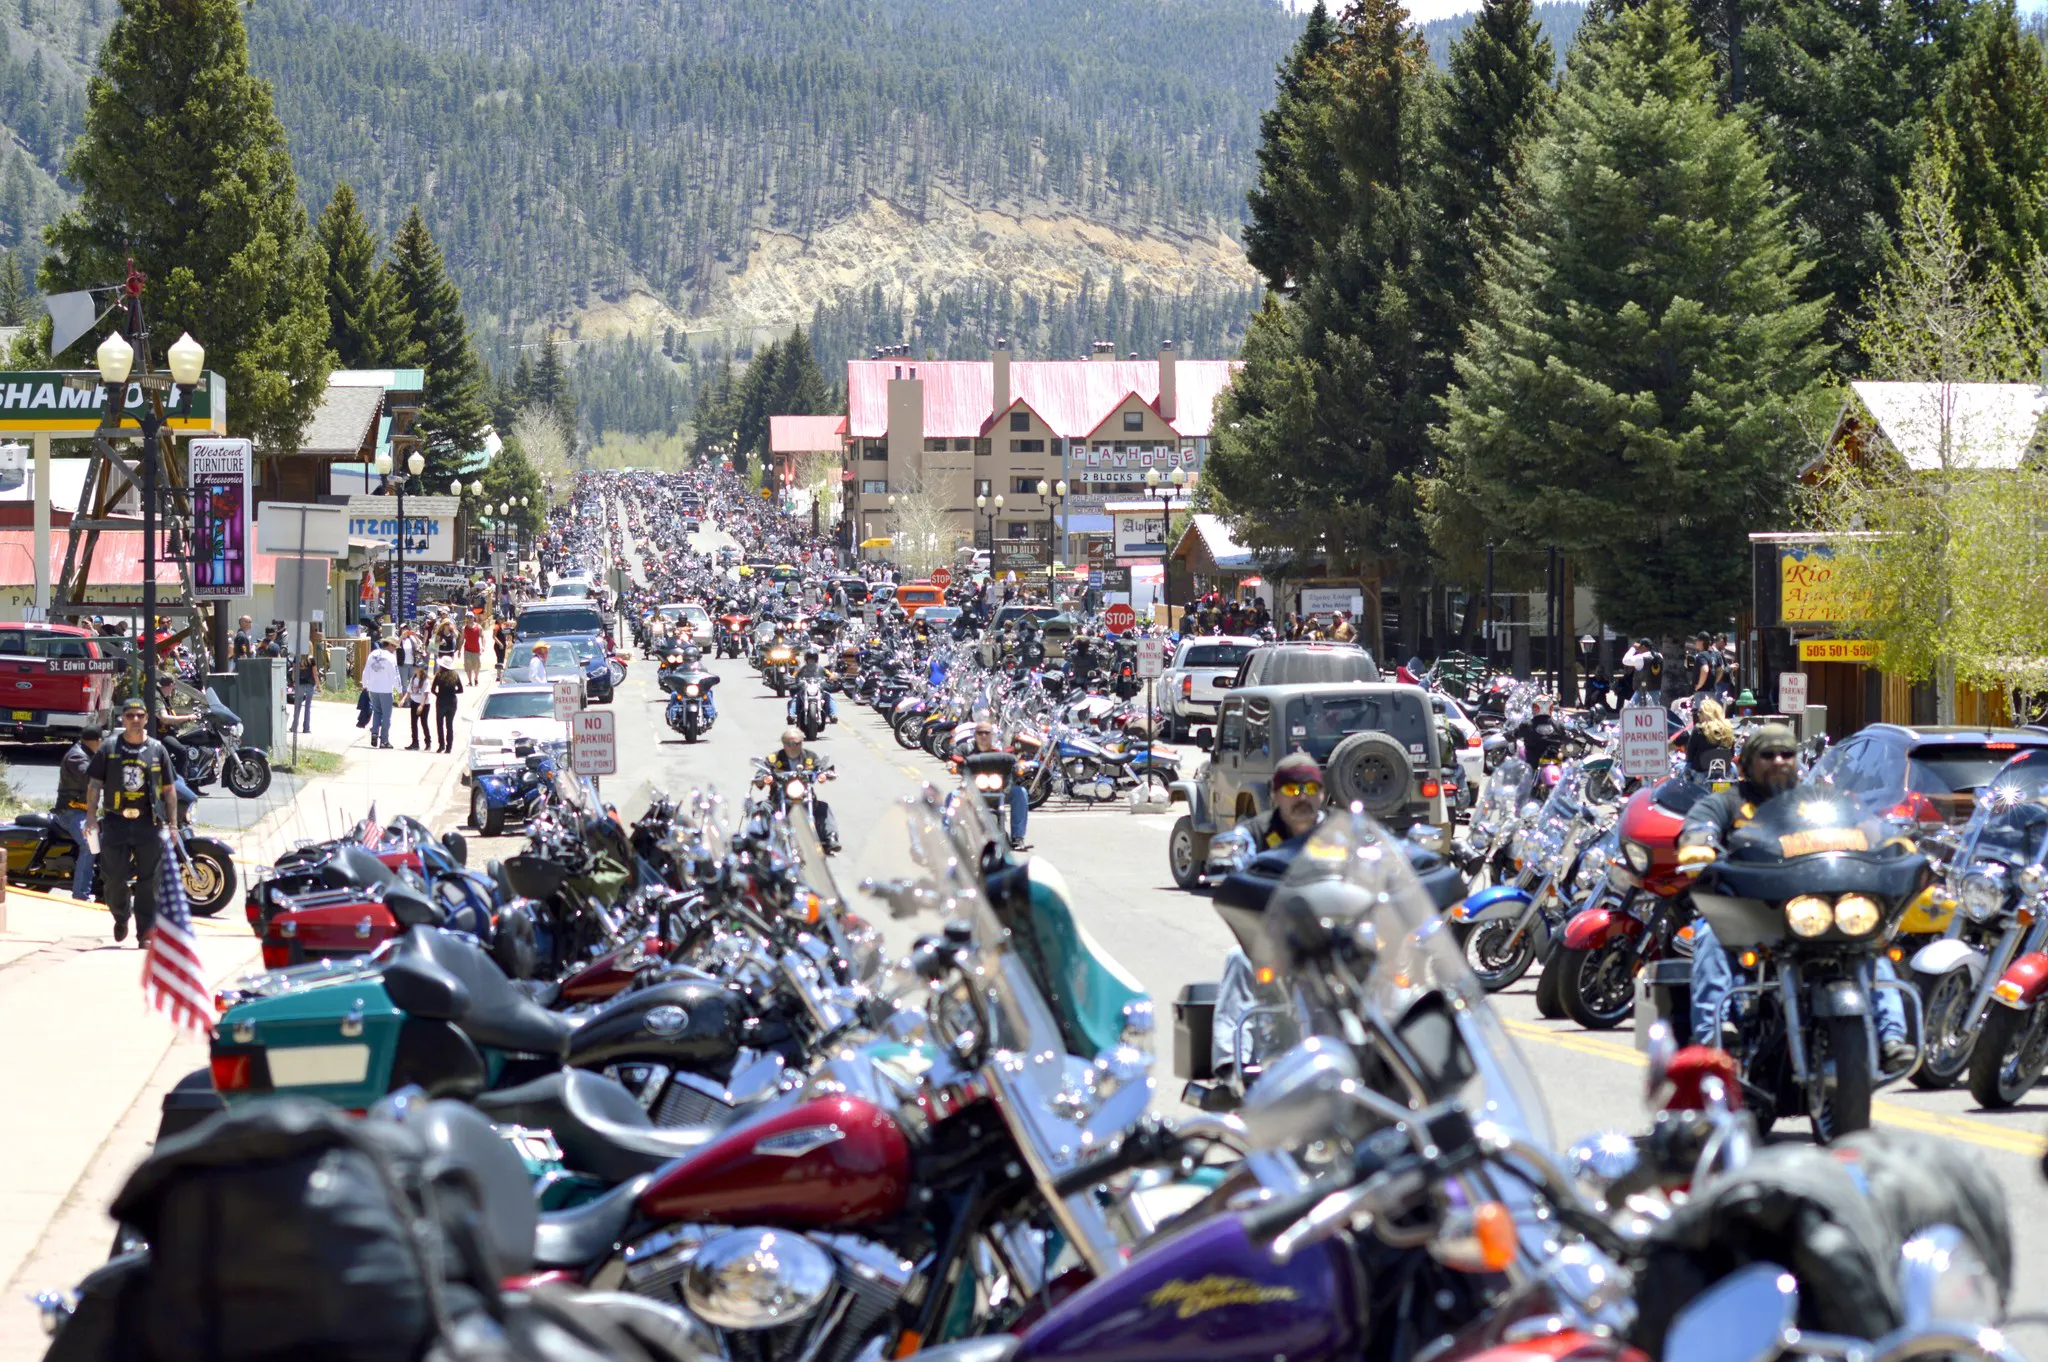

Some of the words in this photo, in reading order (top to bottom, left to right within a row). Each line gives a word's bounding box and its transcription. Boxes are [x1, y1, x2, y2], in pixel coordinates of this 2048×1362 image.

[194, 445, 243, 457] Westend
[1074, 447, 1194, 466] PLAYHOUSE
[194, 458, 244, 472] FURNITURE
[203, 474, 243, 484] Accessories
[1083, 473, 1088, 481] 2
[1093, 473, 1133, 481] BLOCKS
[1000, 545, 1018, 554] WILD
[1020, 545, 1040, 555] BILL'S
[423, 564, 473, 575] RENTALS
[438, 577, 467, 585] Jewelry
[931, 574, 949, 583] STOP
[1784, 564, 1831, 588] Rio
[222, 586, 230, 594] THE
[231, 586, 244, 594] VALLEY
[1106, 613, 1133, 625] STOP
[1785, 608, 1817, 620] 517
[1145, 642, 1156, 651] NO
[1806, 645, 1826, 657] 505
[1140, 651, 1161, 659] PARKING
[50, 661, 60, 671] St.
[63, 660, 86, 671] Edwin
[88, 660, 114, 672] Chapel
[1788, 677, 1798, 686] NO
[561, 686, 571, 695] NO
[1781, 687, 1804, 695] PARKING
[556, 696, 577, 704] PARKING
[585, 717, 602, 730] NO
[1635, 714, 1653, 727] NO
[575, 733, 612, 744] PARKING
[1625, 731, 1664, 743] PARKING
[581, 749, 607, 757] BEYOND
[1632, 748, 1659, 756] BEYOND
[594, 760, 612, 768] POINT
[1627, 760, 1641, 768] THIS
[1645, 760, 1664, 768] POINT
